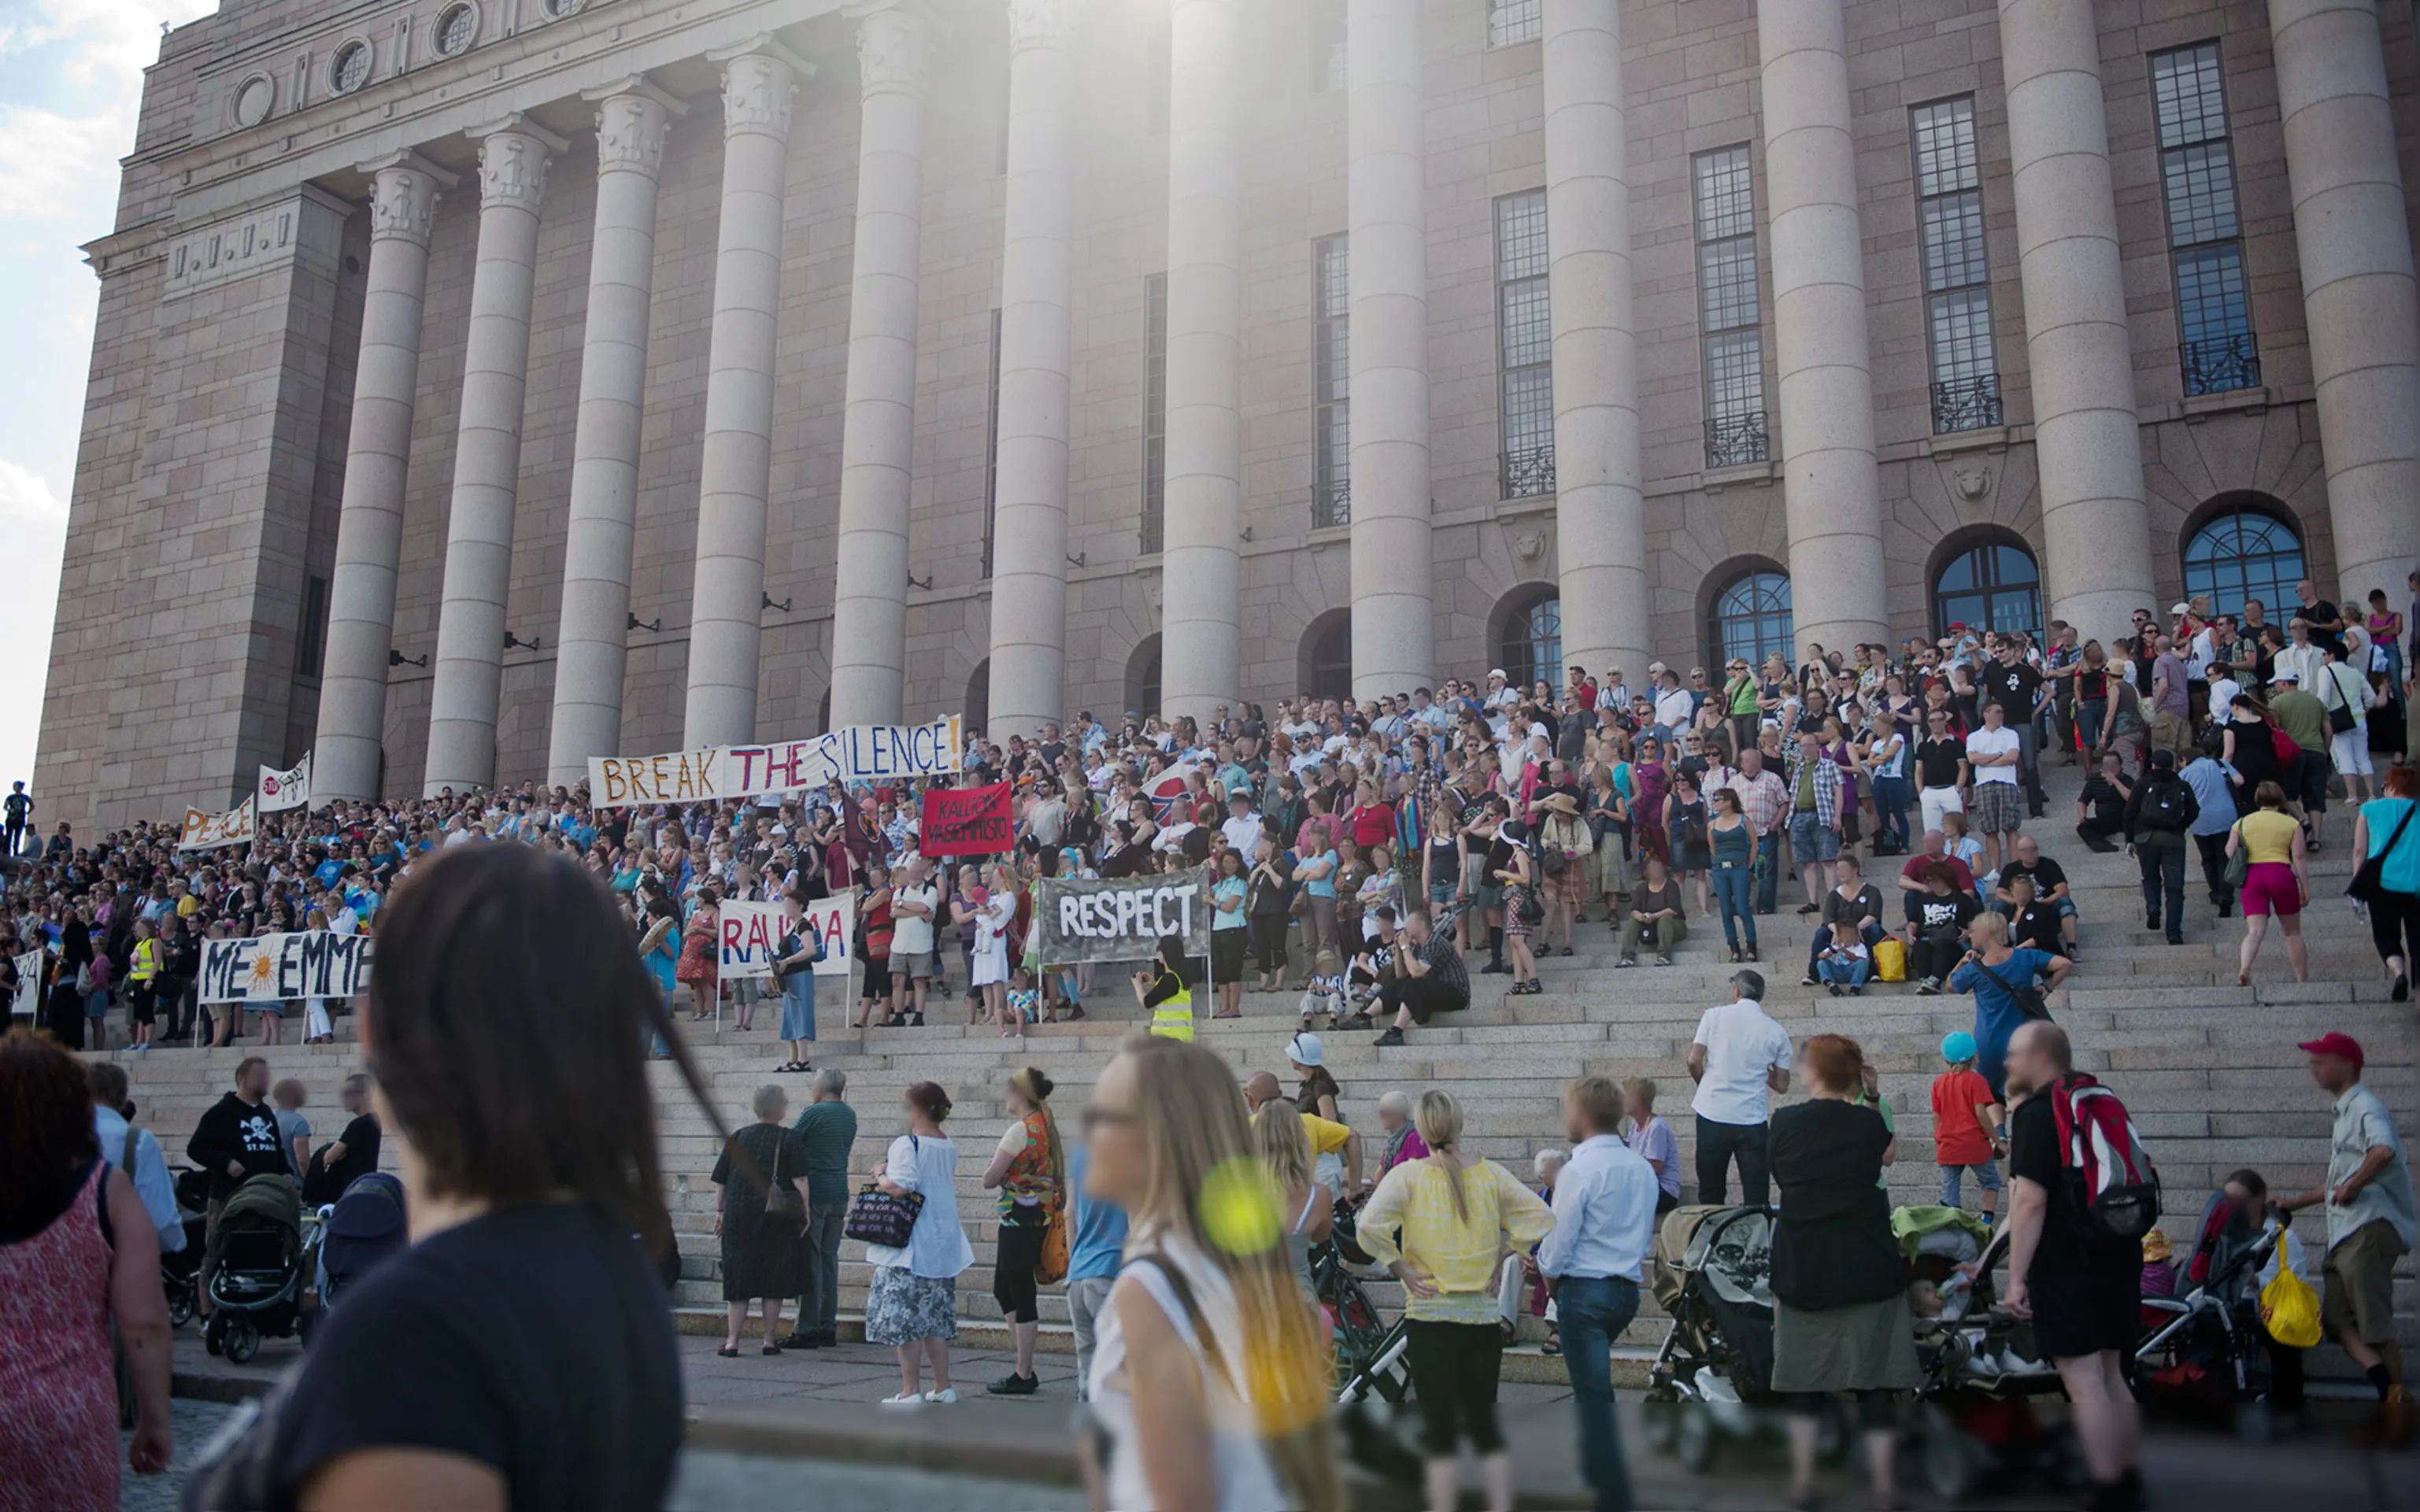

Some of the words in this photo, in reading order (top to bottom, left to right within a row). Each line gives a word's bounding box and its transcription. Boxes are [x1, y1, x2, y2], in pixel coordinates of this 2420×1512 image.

[603, 749, 716, 803] BREAK
[730, 743, 807, 792] THE
[820, 718, 960, 781] SILENCE!
[1060, 883, 1198, 938] RESPECT
[205, 939, 258, 999] ME
[279, 932, 373, 998] EMME
